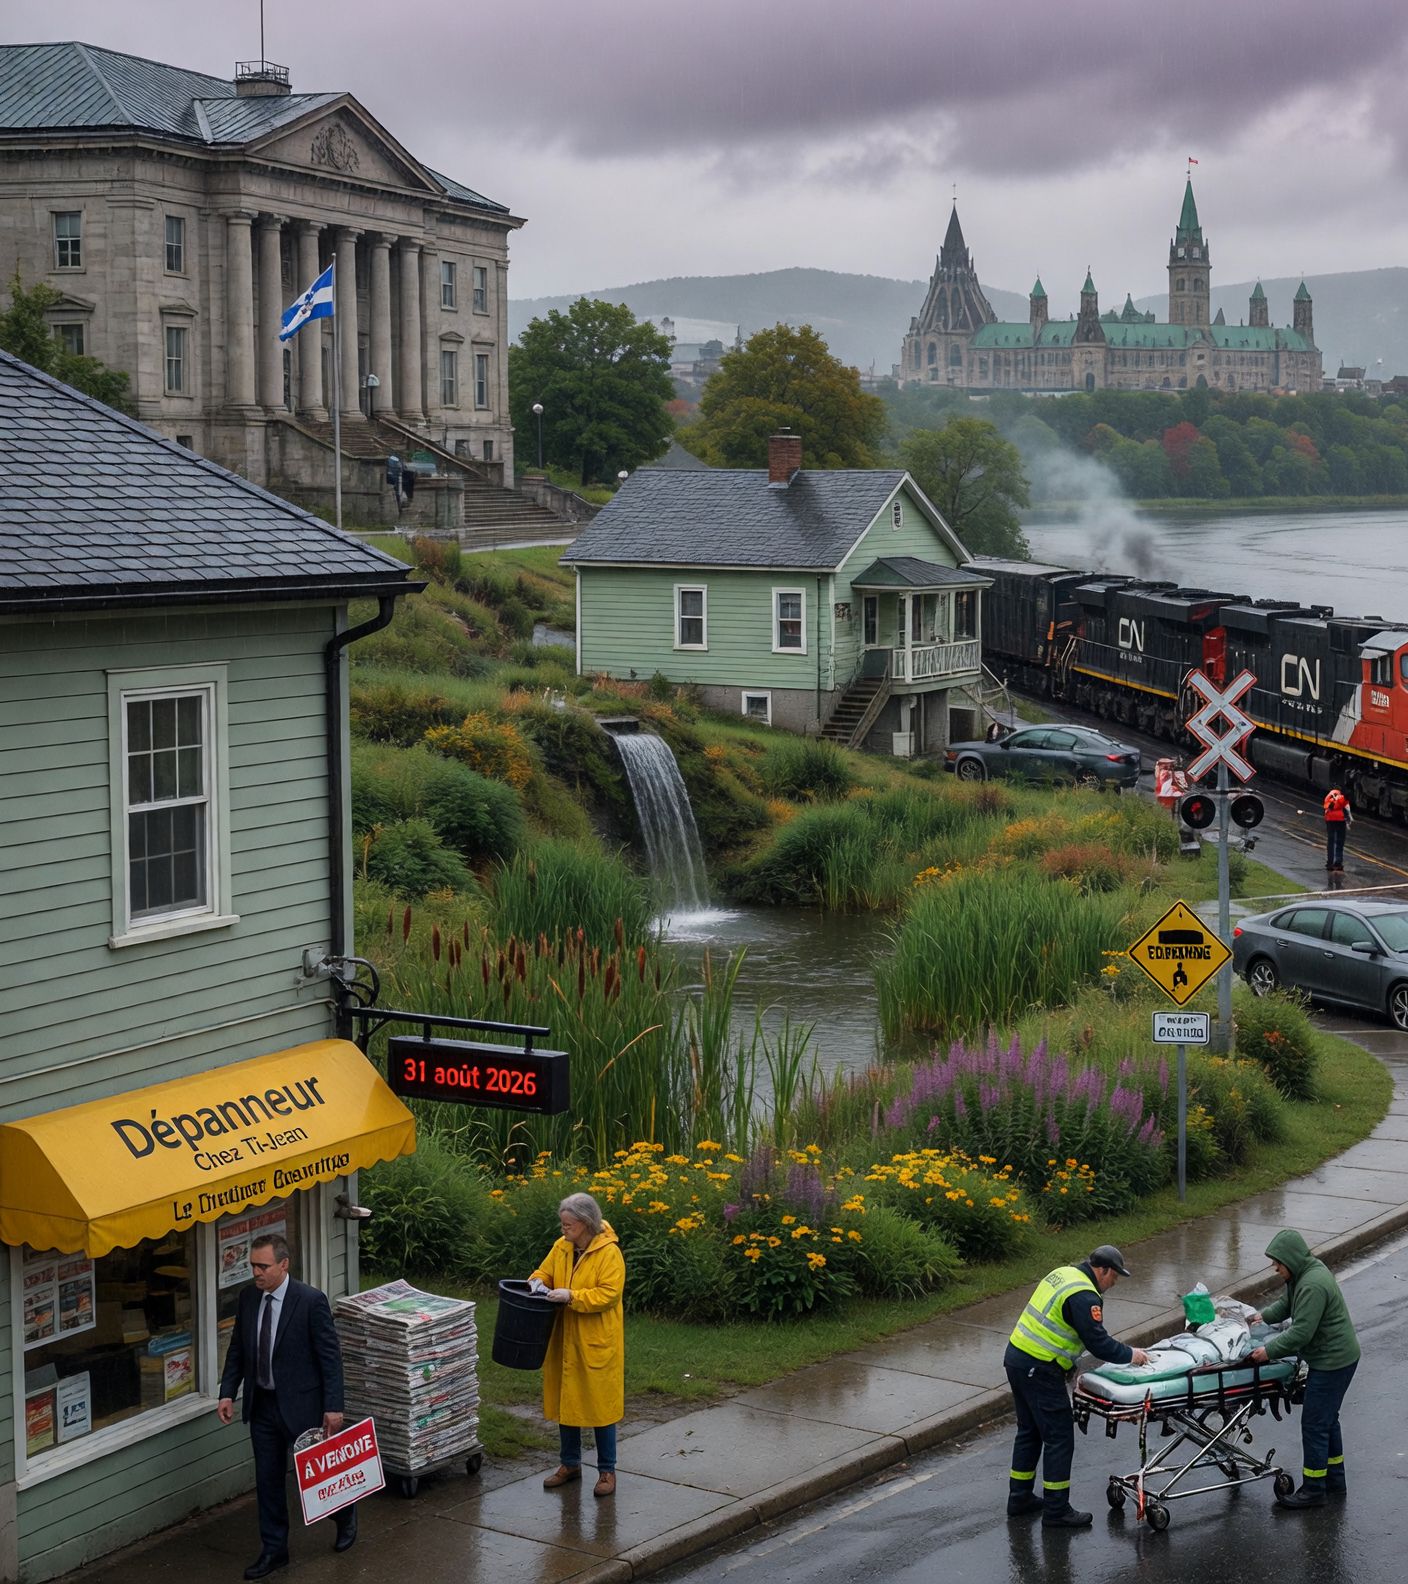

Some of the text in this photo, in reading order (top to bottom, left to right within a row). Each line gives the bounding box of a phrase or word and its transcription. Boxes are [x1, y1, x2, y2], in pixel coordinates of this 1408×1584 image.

[1118, 617, 1145, 652] CN
[1281, 653, 1321, 700] CN
[404, 1058, 537, 1096] 31 août 2026
[110, 1076, 326, 1160] Dépanneur
[193, 1147, 244, 1172] Chez
[240, 1127, 309, 1156] Ti-Jean
